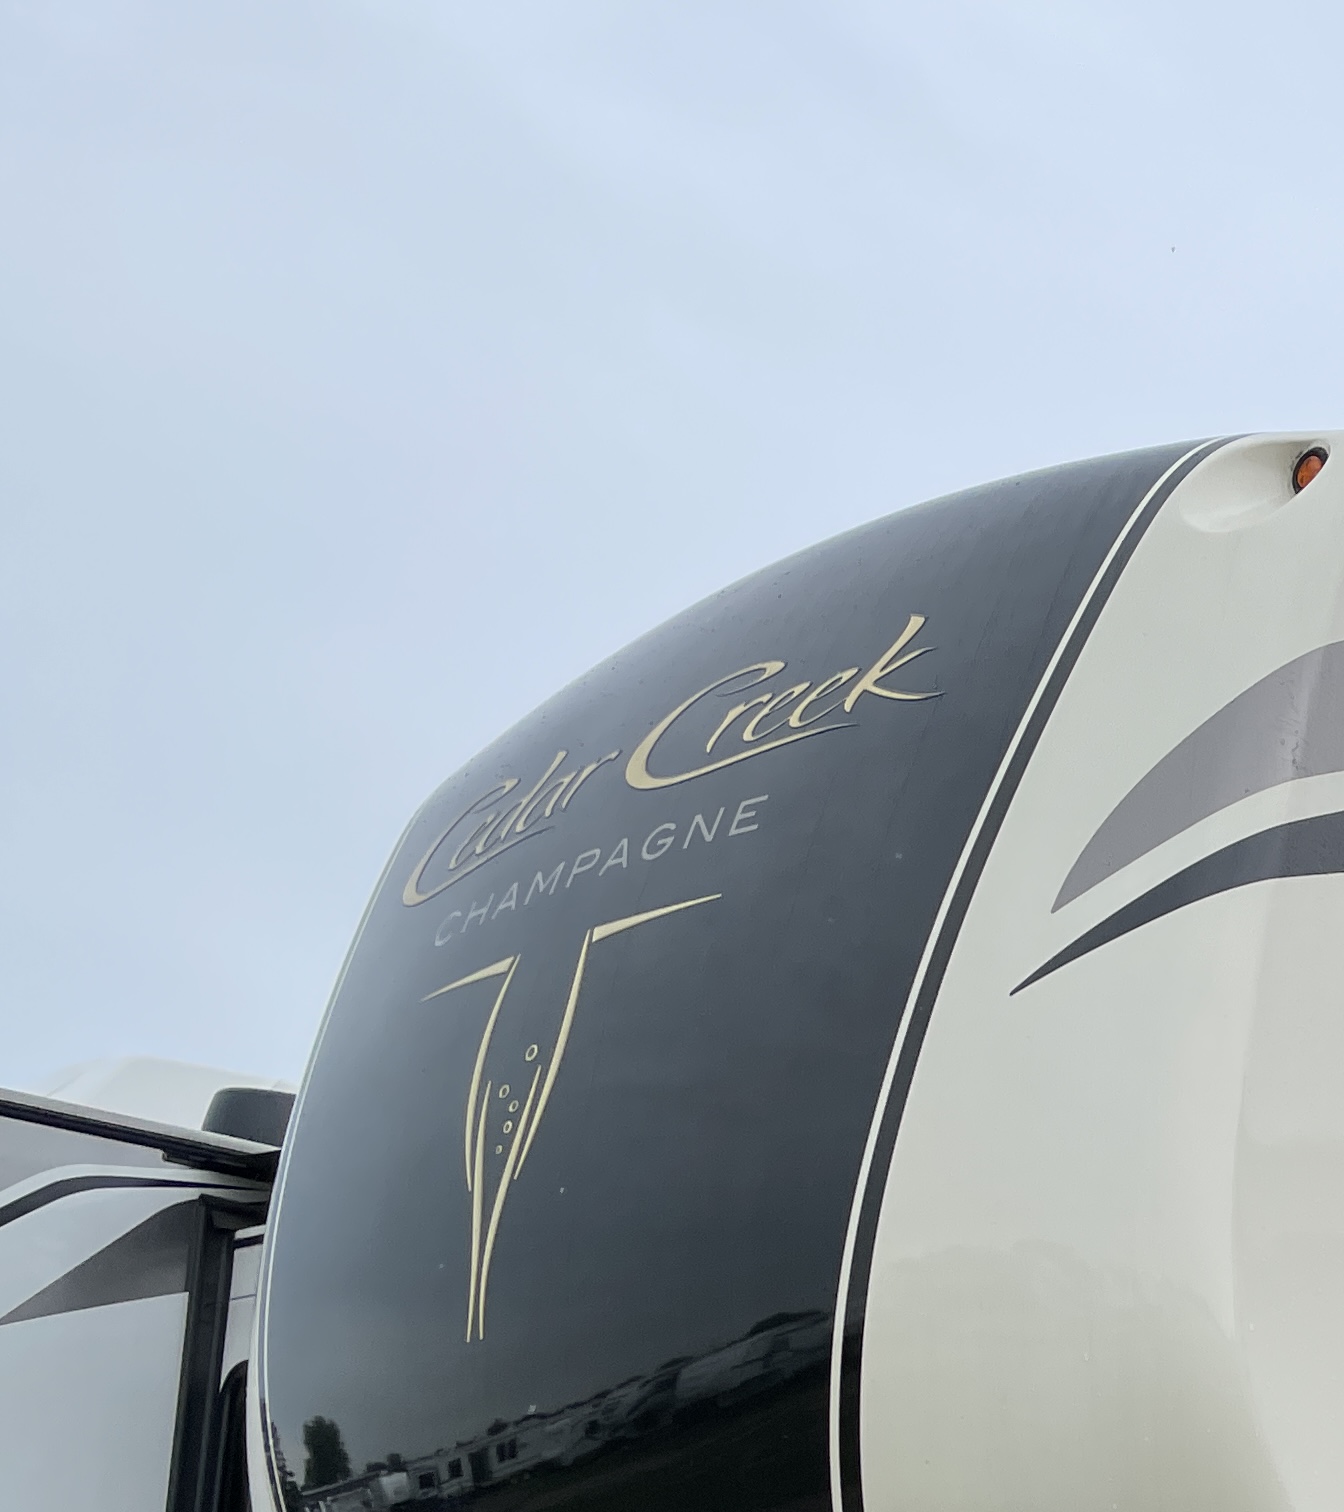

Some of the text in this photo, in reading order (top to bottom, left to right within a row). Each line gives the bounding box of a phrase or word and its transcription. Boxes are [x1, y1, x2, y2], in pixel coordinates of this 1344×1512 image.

[402, 613, 946, 908] Cedar Creek
[434, 793, 770, 948] CHAMPAGNE
